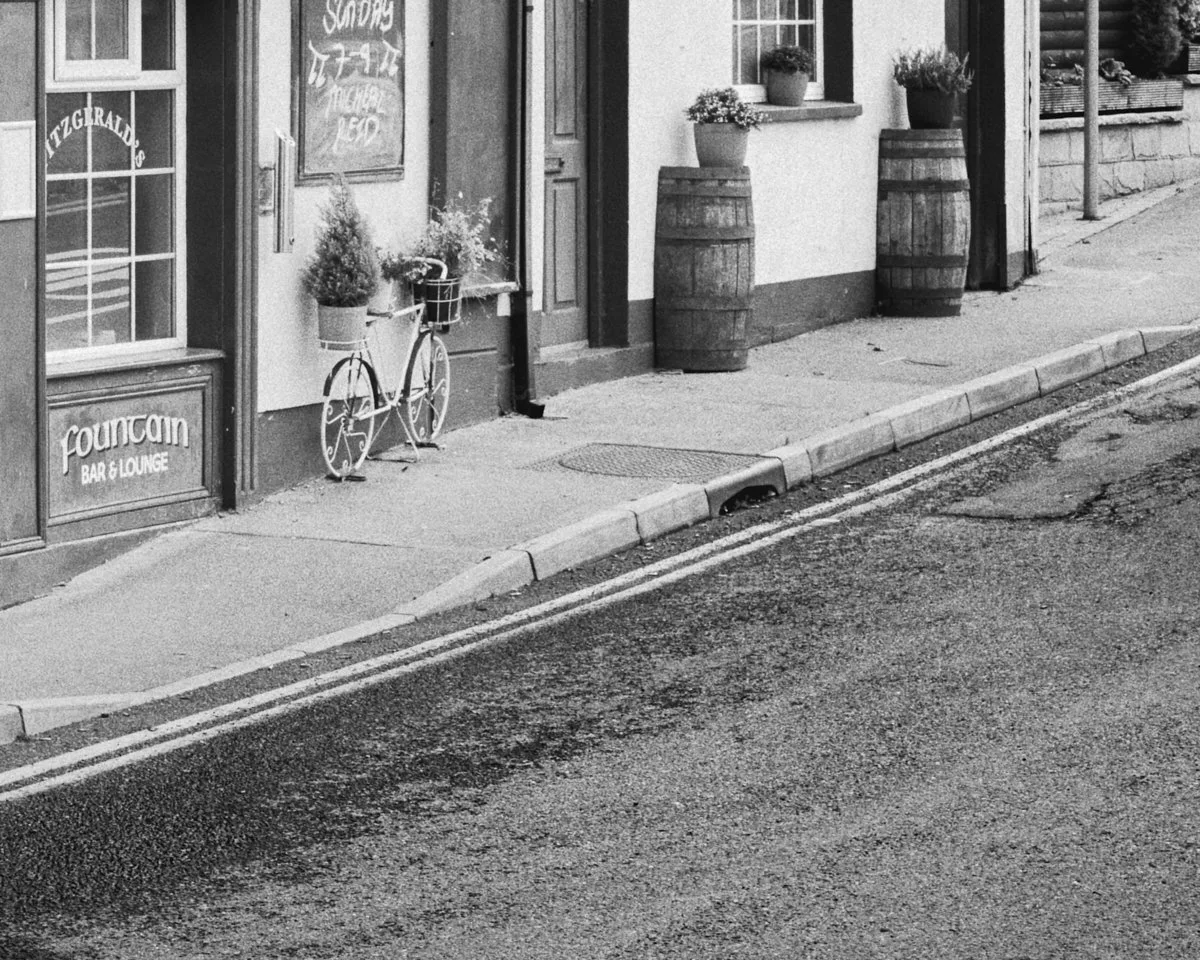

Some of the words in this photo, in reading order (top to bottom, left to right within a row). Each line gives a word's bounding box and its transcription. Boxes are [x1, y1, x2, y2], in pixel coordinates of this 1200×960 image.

[45, 106, 146, 168] ITZGERALD'S
[81, 461, 106, 485] BAR
[108, 462, 117, 480] &
[119, 451, 169, 478] LOUNGE
